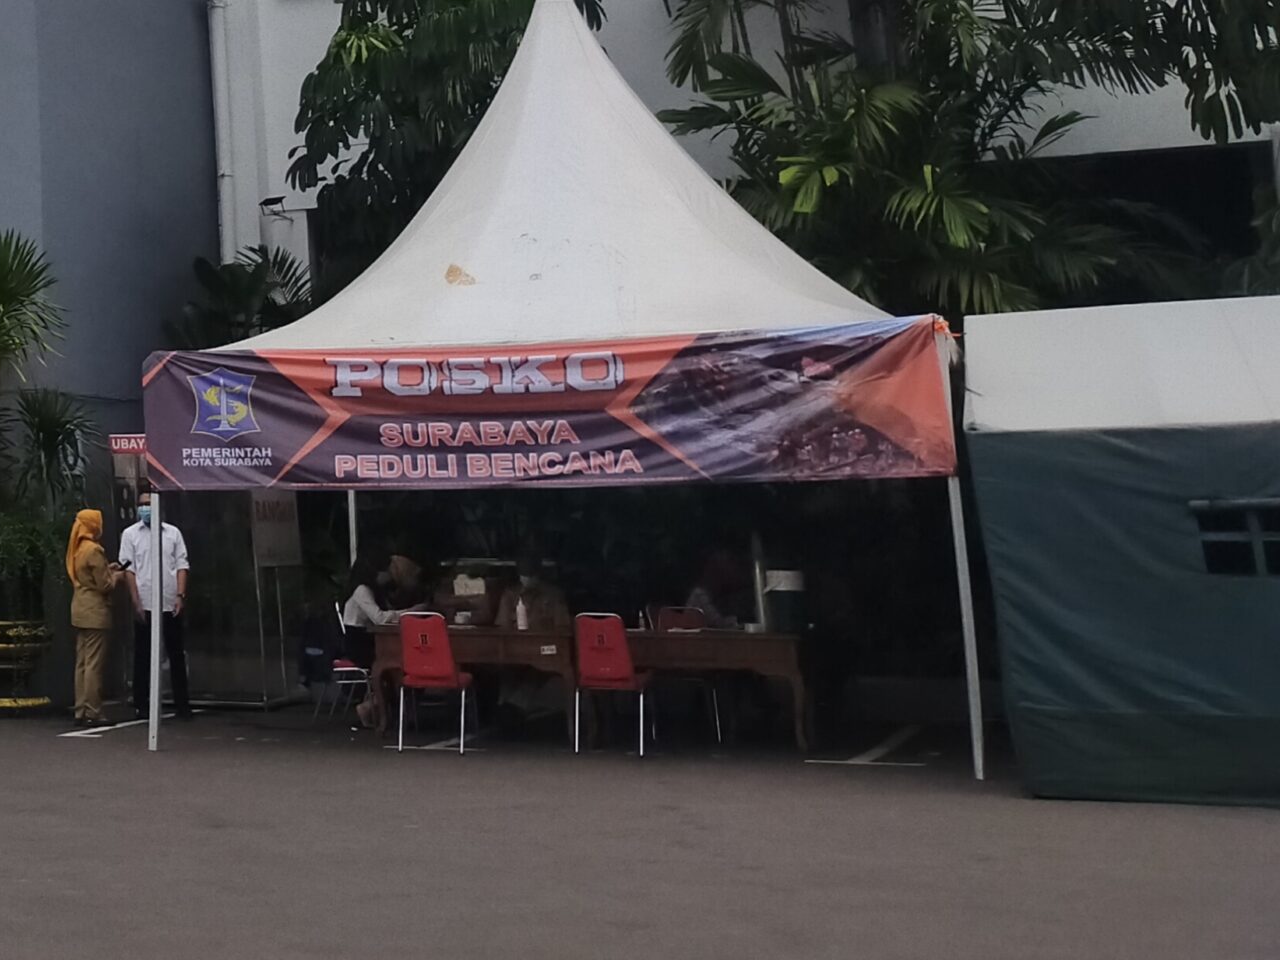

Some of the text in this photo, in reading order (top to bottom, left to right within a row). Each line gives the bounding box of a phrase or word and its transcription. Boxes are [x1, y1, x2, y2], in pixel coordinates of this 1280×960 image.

[326, 351, 624, 397] POSKO
[111, 438, 147, 450] UBAY
[379, 420, 580, 448] SURABAYA
[182, 447, 272, 458] PEMERINTAH
[183, 458, 272, 467] KOTA SURABAYA
[334, 449, 643, 479] PEDULI BENCANA
